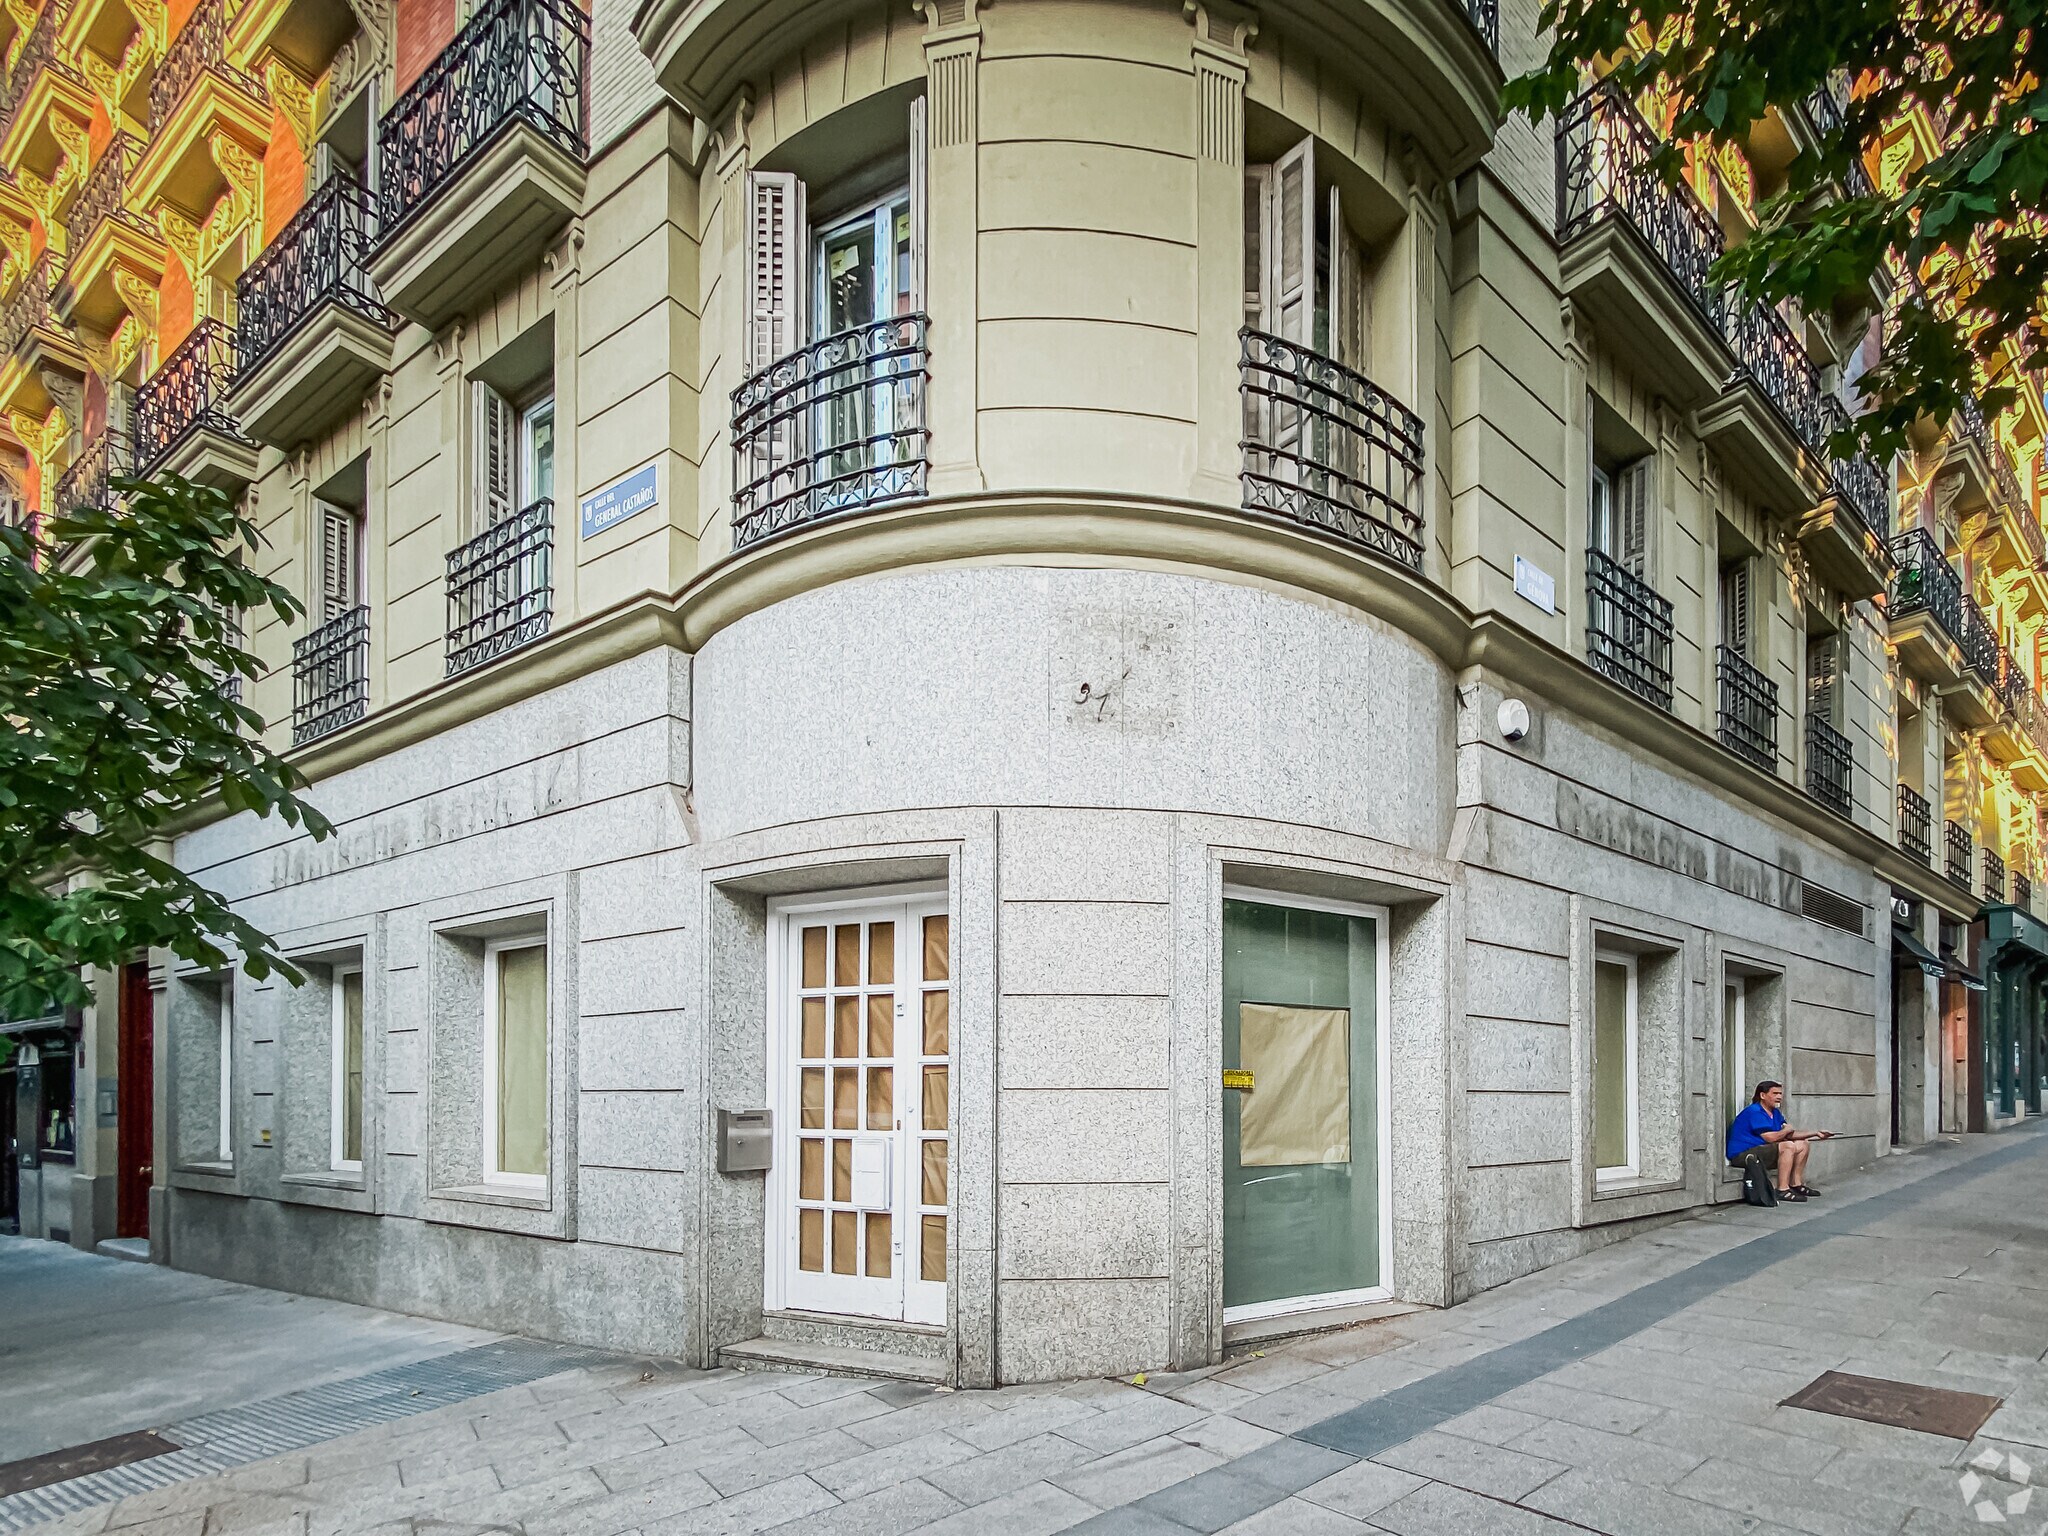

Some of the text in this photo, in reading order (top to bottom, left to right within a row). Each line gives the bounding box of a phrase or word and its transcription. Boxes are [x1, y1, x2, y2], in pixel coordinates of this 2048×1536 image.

[594, 492, 615, 510] CALLE DEL
[594, 486, 654, 528] GENERAL CASTAÑOS
